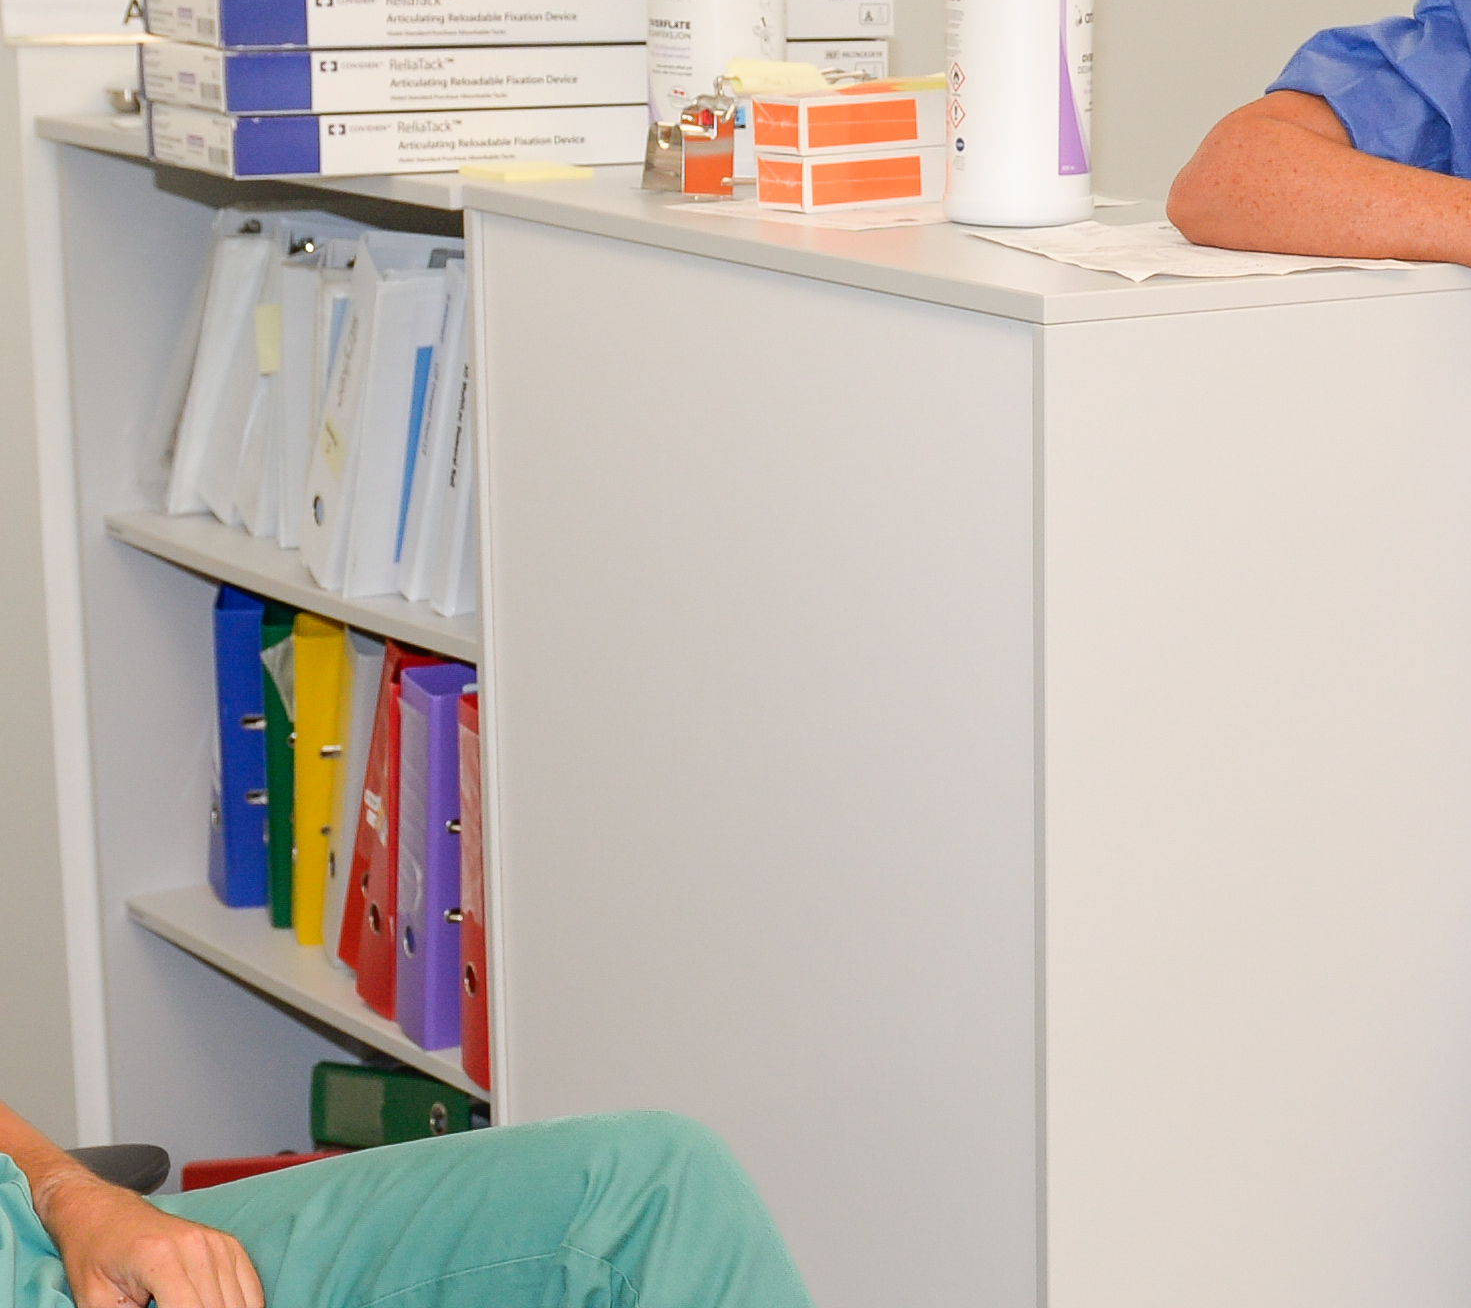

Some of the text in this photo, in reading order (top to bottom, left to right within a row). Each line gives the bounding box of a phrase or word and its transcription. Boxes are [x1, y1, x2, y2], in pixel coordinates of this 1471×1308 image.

[386, 11, 578, 25] Articulating Reloadable Fixation Device
[390, 74, 578, 90] Articulating Reloadable Fixation Device
[398, 134, 586, 152] Articulating Reloadable Fixation Device
